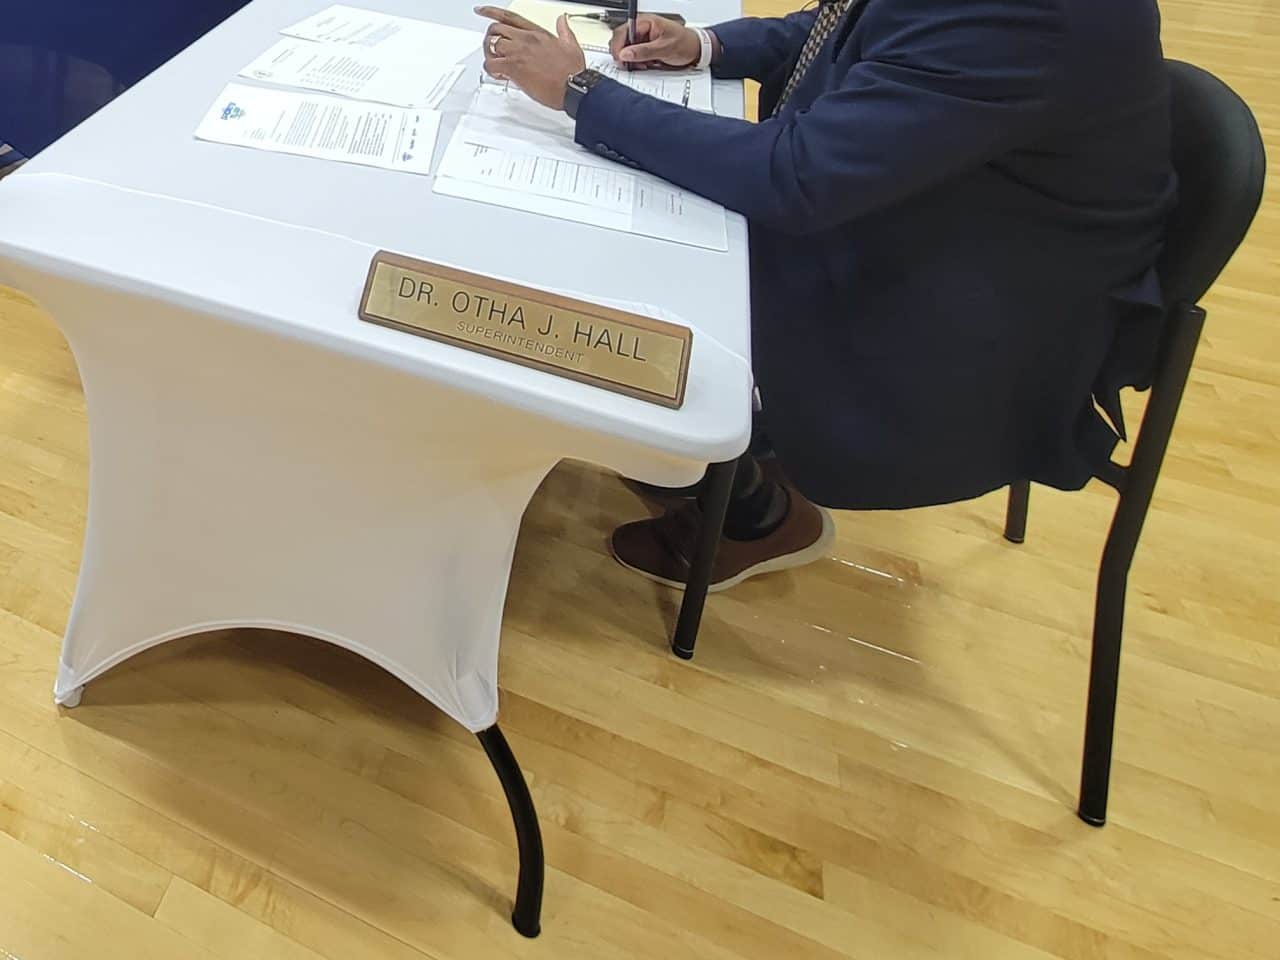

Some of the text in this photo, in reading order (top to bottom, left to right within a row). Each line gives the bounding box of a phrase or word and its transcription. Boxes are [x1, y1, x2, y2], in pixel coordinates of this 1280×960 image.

[398, 276, 647, 362] DR. OTHA J. HALL
[456, 320, 585, 363] SUPERINTENDENT
